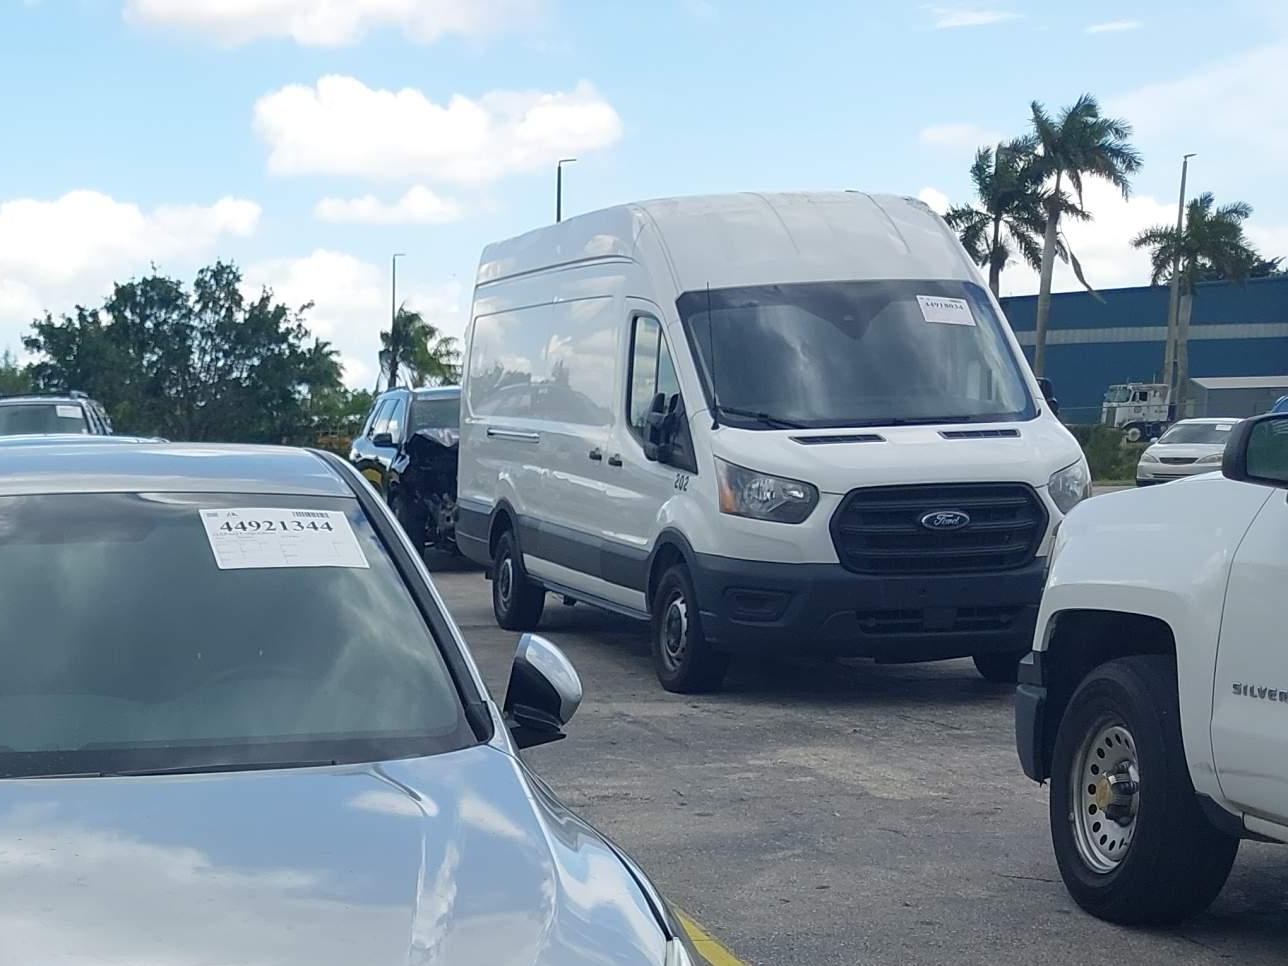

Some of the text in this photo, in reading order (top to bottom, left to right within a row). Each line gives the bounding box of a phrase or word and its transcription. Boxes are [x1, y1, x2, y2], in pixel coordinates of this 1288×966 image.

[674, 473, 689, 491] 202
[220, 520, 334, 532] 44921344
[1232, 682, 1288, 704] SILVER
